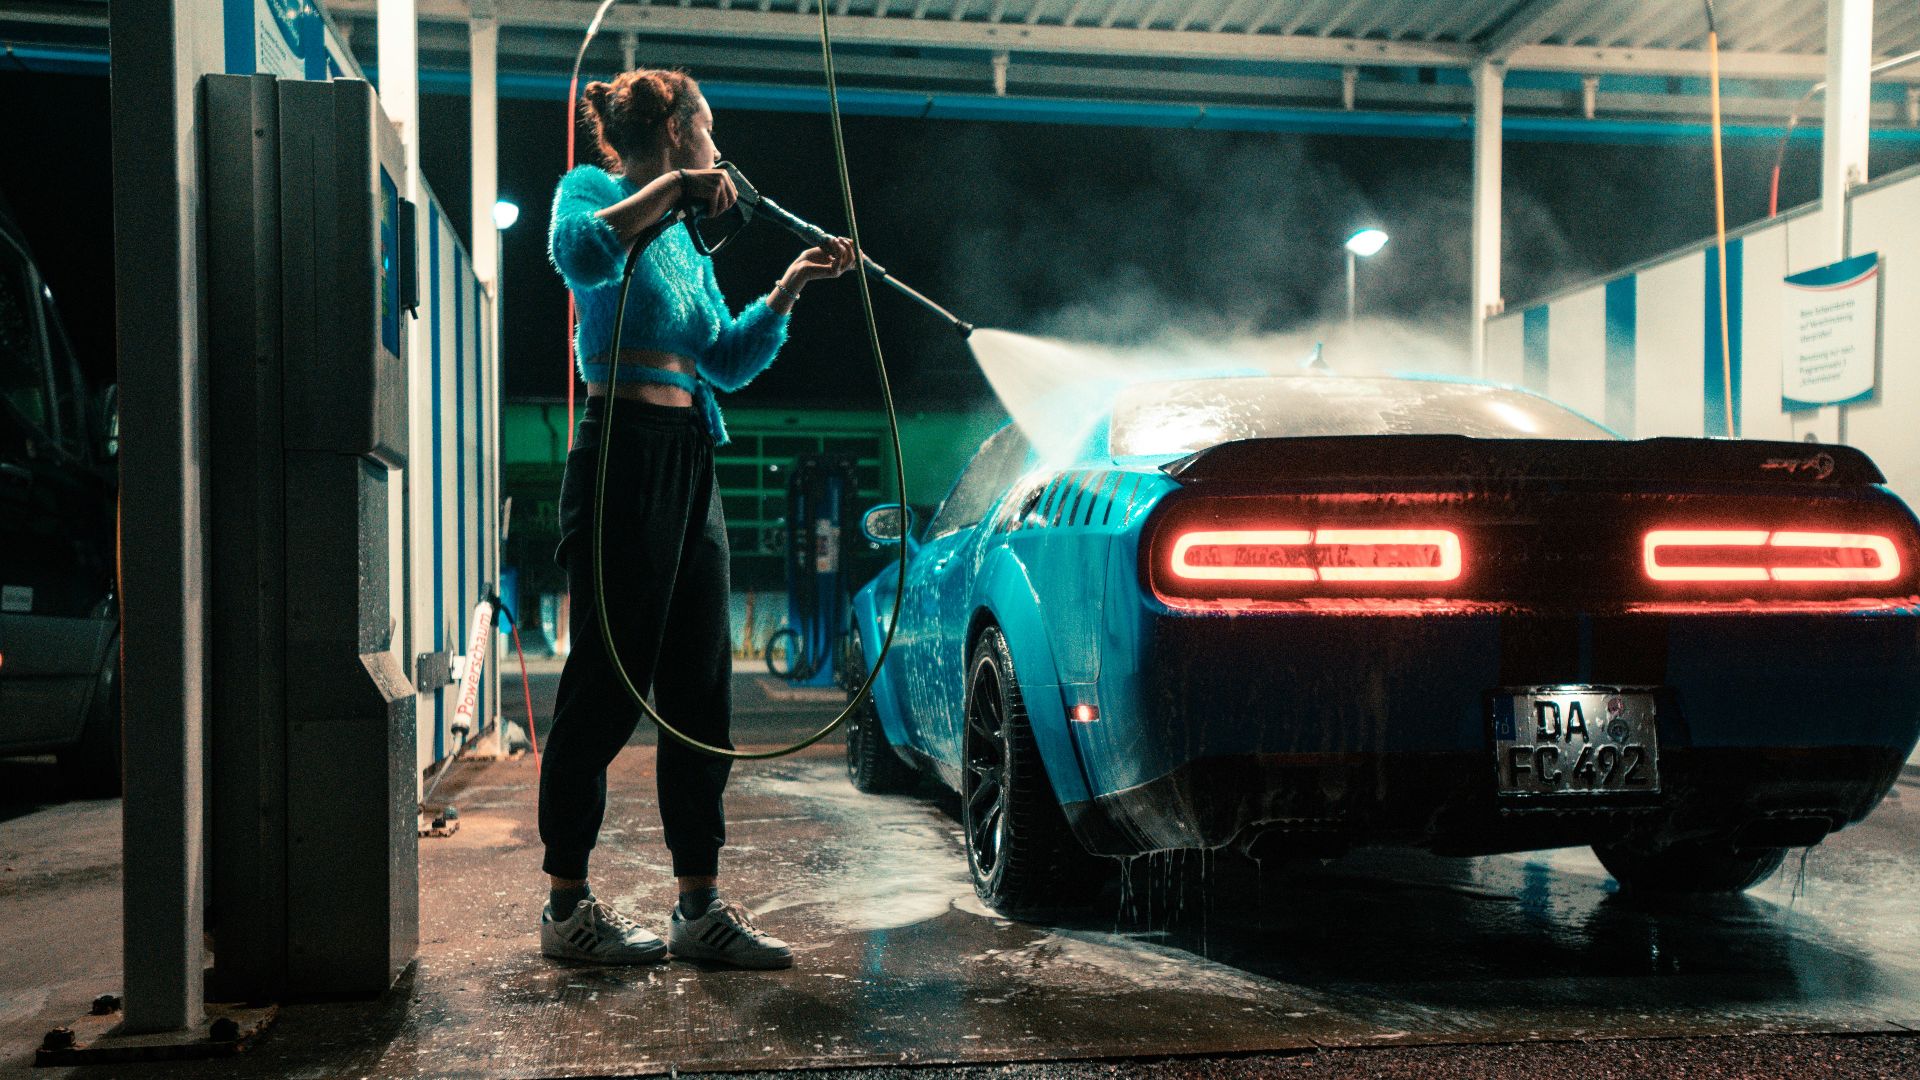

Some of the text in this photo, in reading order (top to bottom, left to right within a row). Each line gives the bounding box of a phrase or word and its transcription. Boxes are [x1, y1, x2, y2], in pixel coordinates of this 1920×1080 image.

[457, 613, 492, 717] Powerschaum
[1535, 701, 1590, 743] DA
[1509, 745, 1649, 785] FC 492
